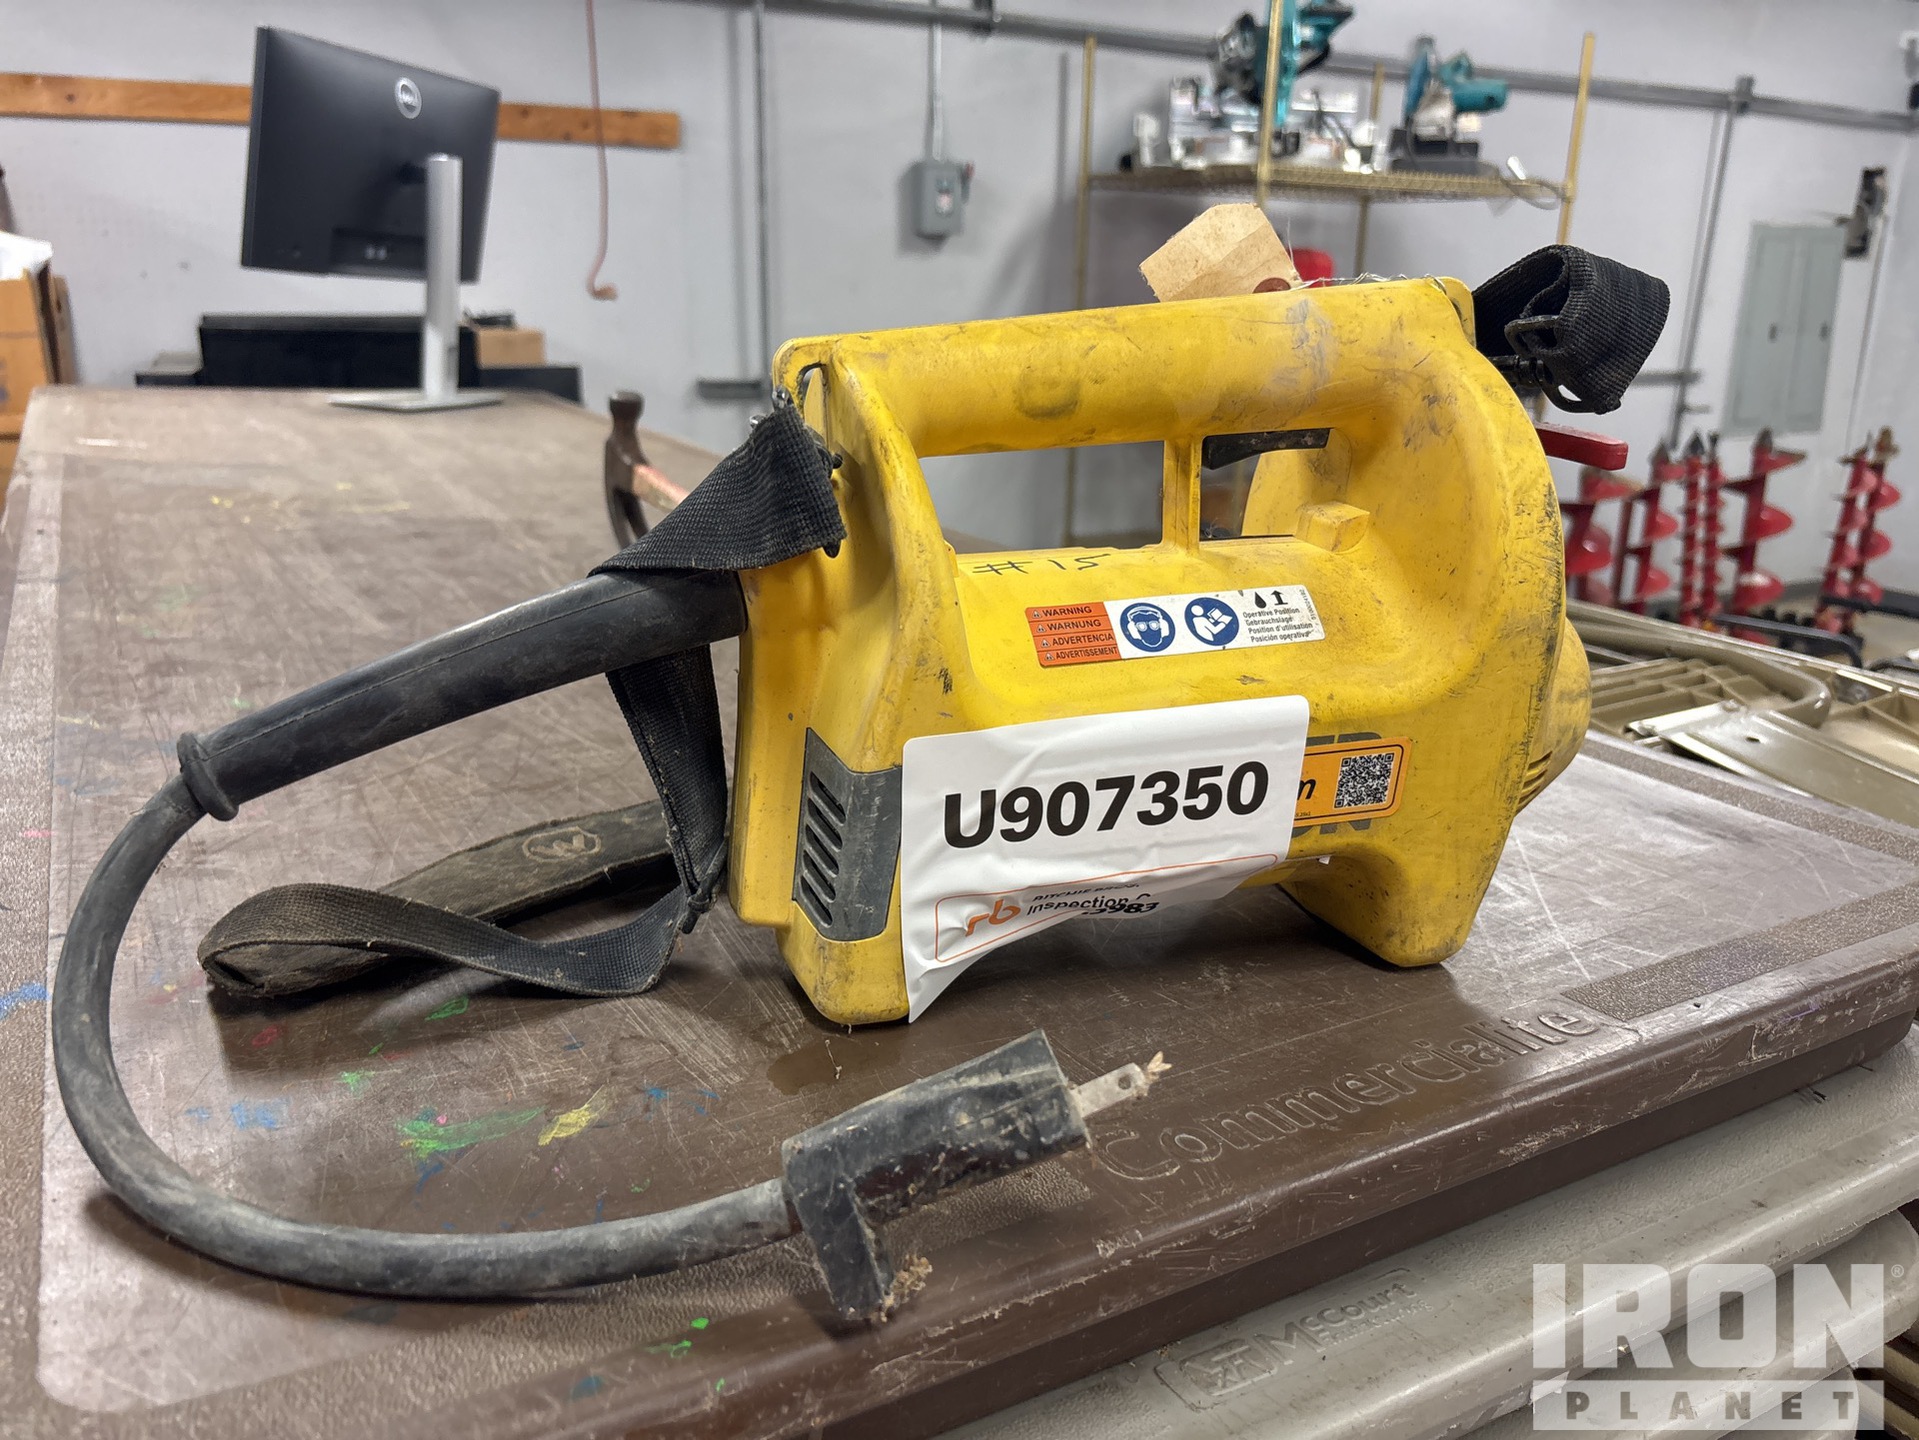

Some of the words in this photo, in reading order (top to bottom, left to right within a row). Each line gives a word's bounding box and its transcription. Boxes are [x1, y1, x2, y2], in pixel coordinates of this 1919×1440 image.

[1042, 606, 1092, 617] WARNING
[1243, 610, 1273, 618] Operative
[1047, 619, 1101, 631] WARNUNG
[1245, 616, 1293, 627] Gebrauchslage
[1248, 626, 1274, 635] Position
[1052, 633, 1114, 647] ADVERTENCIA
[1056, 646, 1118, 660] ADVERTISSEMENT
[943, 760, 1269, 850] U907350
[1026, 895, 1129, 916] Inspection
[1101, 1010, 1599, 1180] Commercialite
